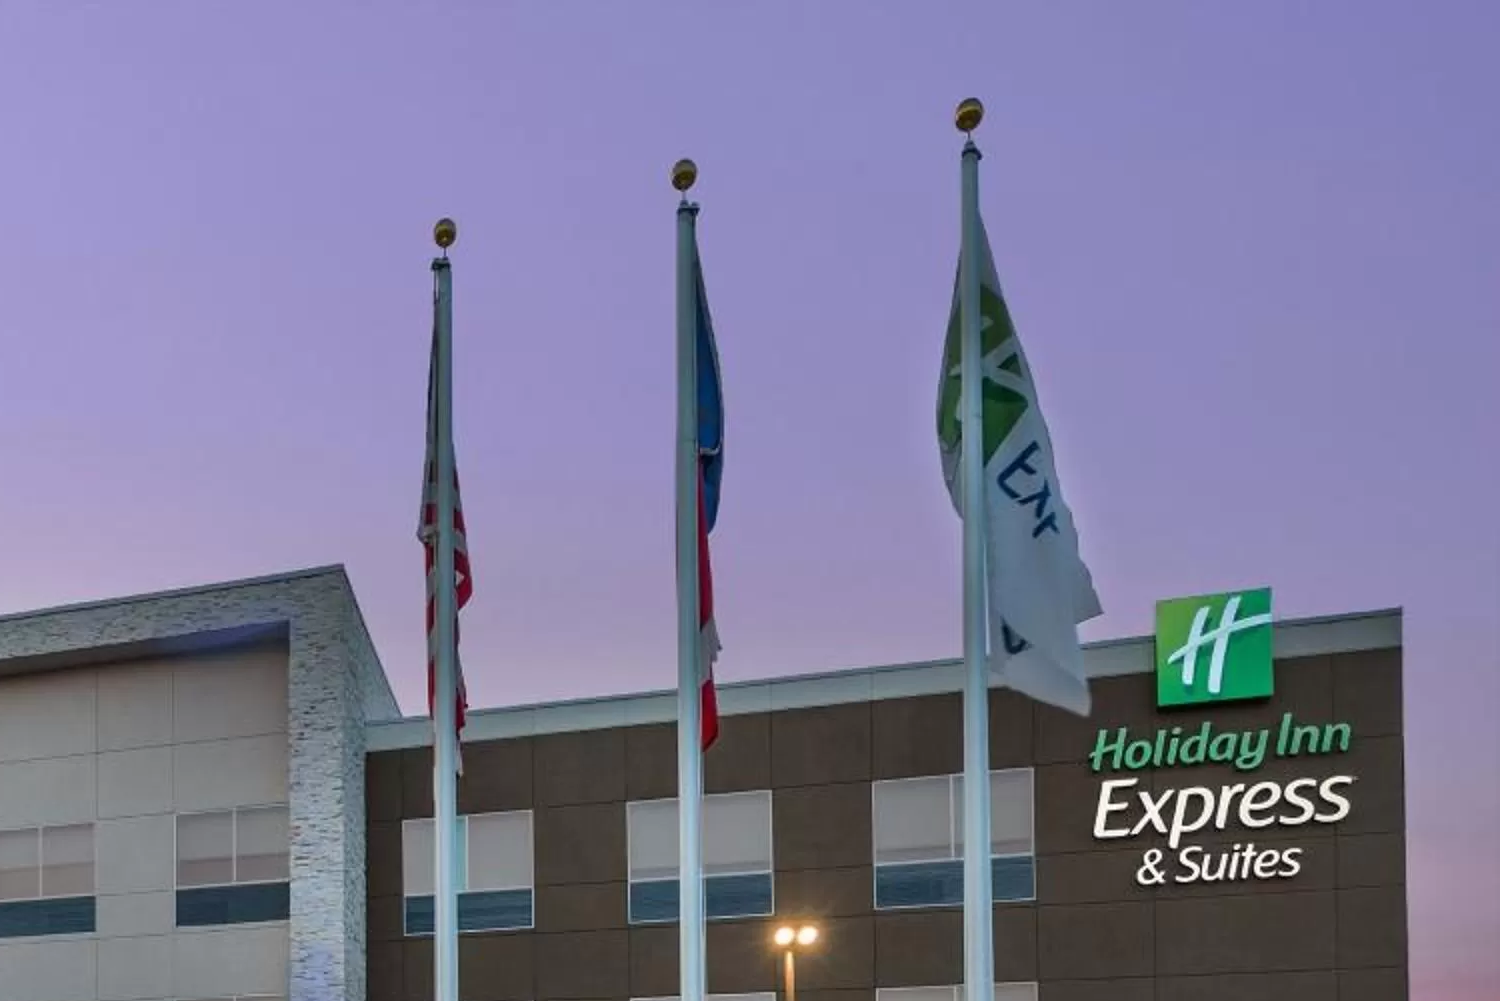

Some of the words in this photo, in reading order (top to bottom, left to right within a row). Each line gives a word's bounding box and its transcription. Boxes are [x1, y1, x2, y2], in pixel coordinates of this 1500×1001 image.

[1167, 595, 1272, 694] H
[1089, 721, 1269, 770] Holiday
[1277, 712, 1352, 756] Inn
[1093, 775, 1353, 849] Express
[1136, 848, 1167, 885] &
[1175, 843, 1302, 883] Suites
